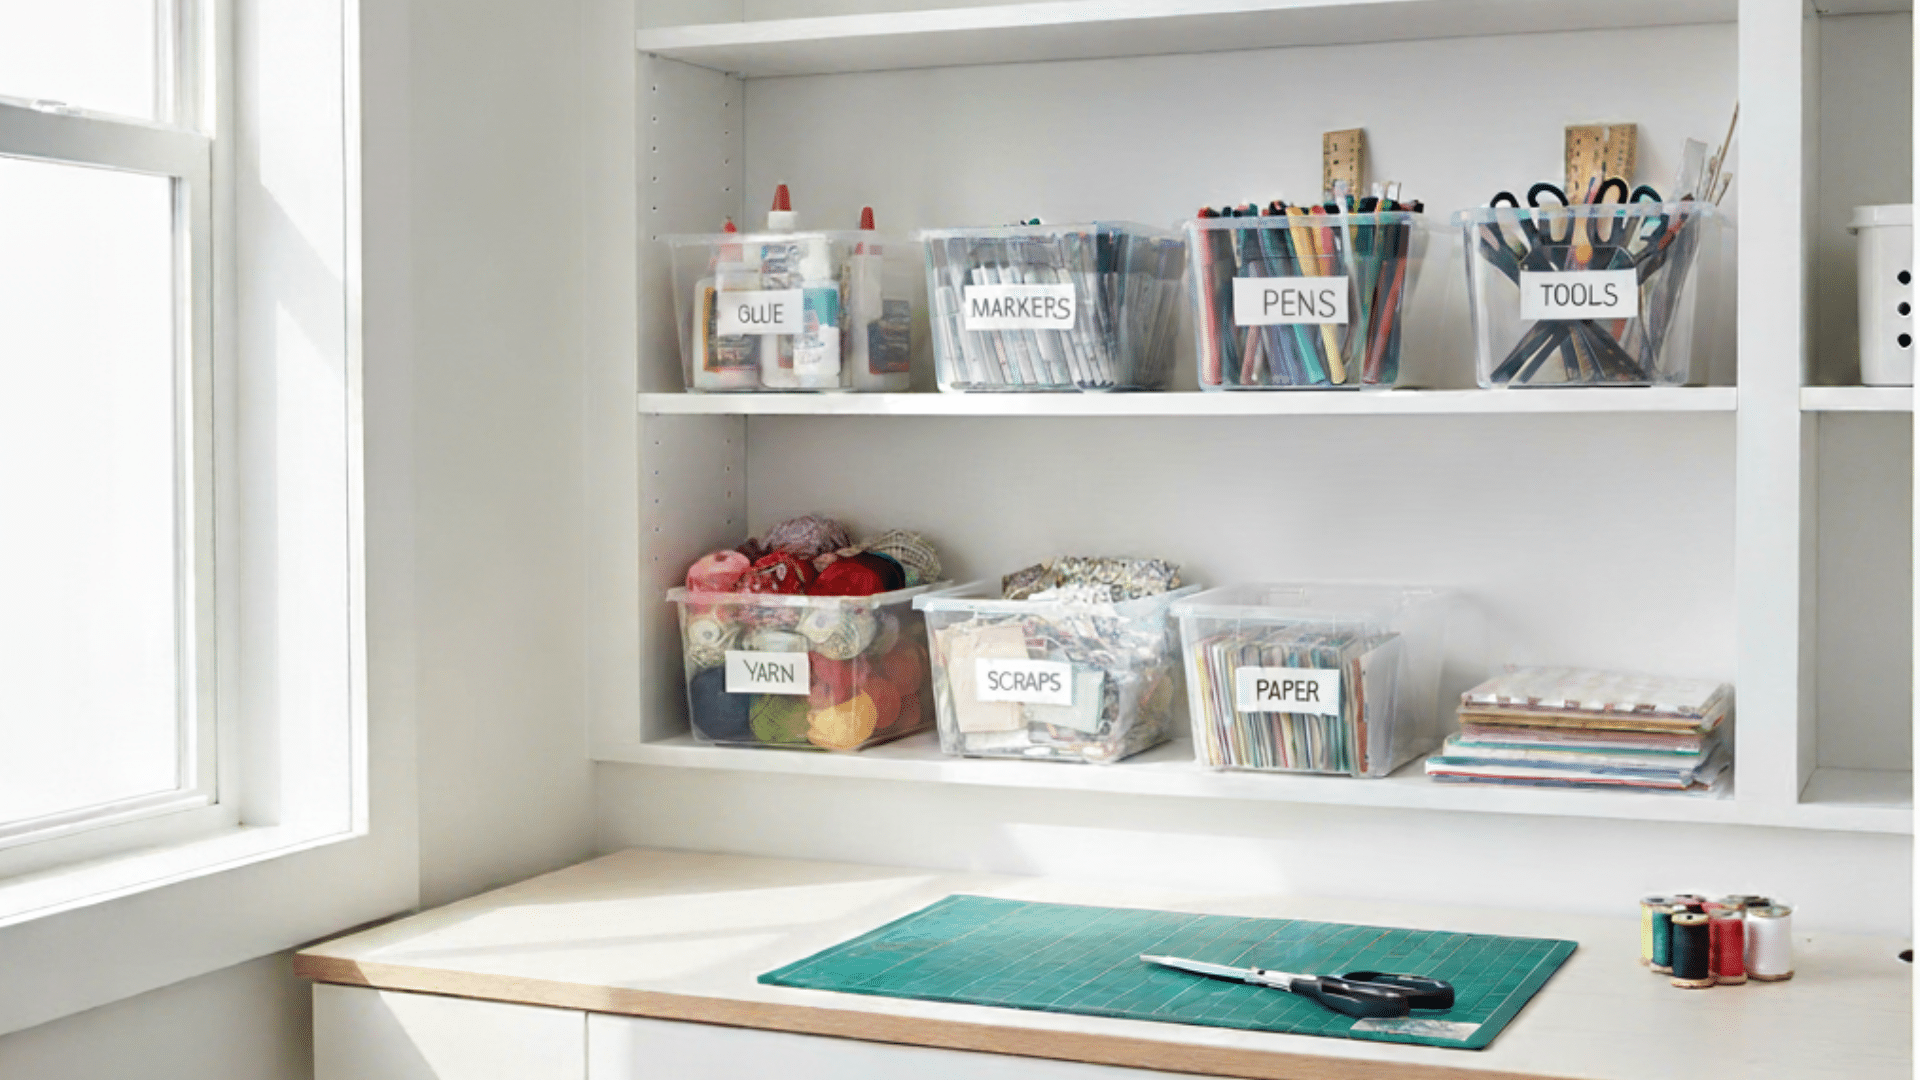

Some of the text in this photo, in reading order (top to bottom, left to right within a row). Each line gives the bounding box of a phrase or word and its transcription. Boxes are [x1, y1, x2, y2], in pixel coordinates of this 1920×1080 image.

[1263, 288, 1336, 318] PENS
[1540, 282, 1619, 307] TOOLS
[738, 303, 784, 324] GLUE
[972, 296, 1071, 320] MARKERS
[743, 659, 795, 683] YARN
[988, 671, 1061, 692] SCRAPS
[1256, 678, 1320, 703] PAPER
